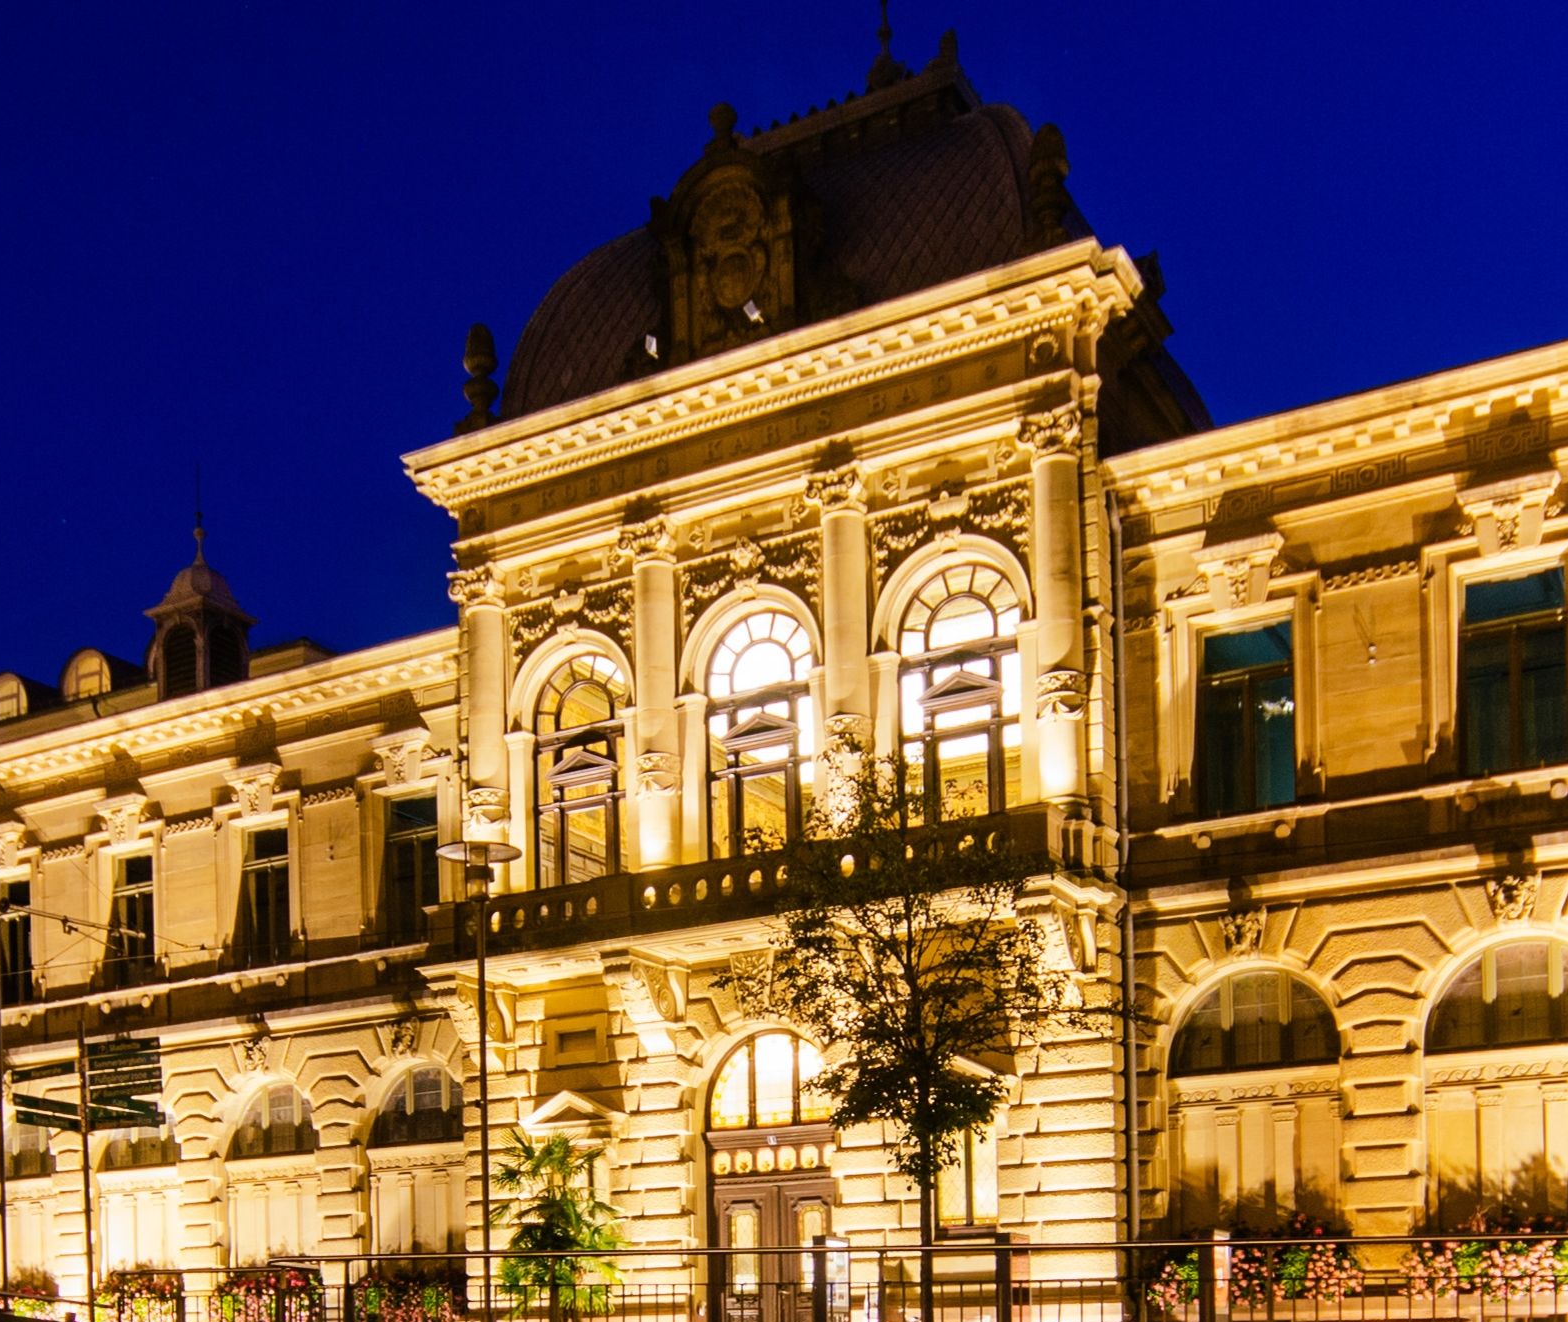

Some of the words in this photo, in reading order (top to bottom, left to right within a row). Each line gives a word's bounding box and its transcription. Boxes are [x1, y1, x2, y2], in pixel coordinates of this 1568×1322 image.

[540, 458, 669, 510] KOENIG
[703, 408, 833, 464] KARLS
[867, 374, 952, 416] BAD
